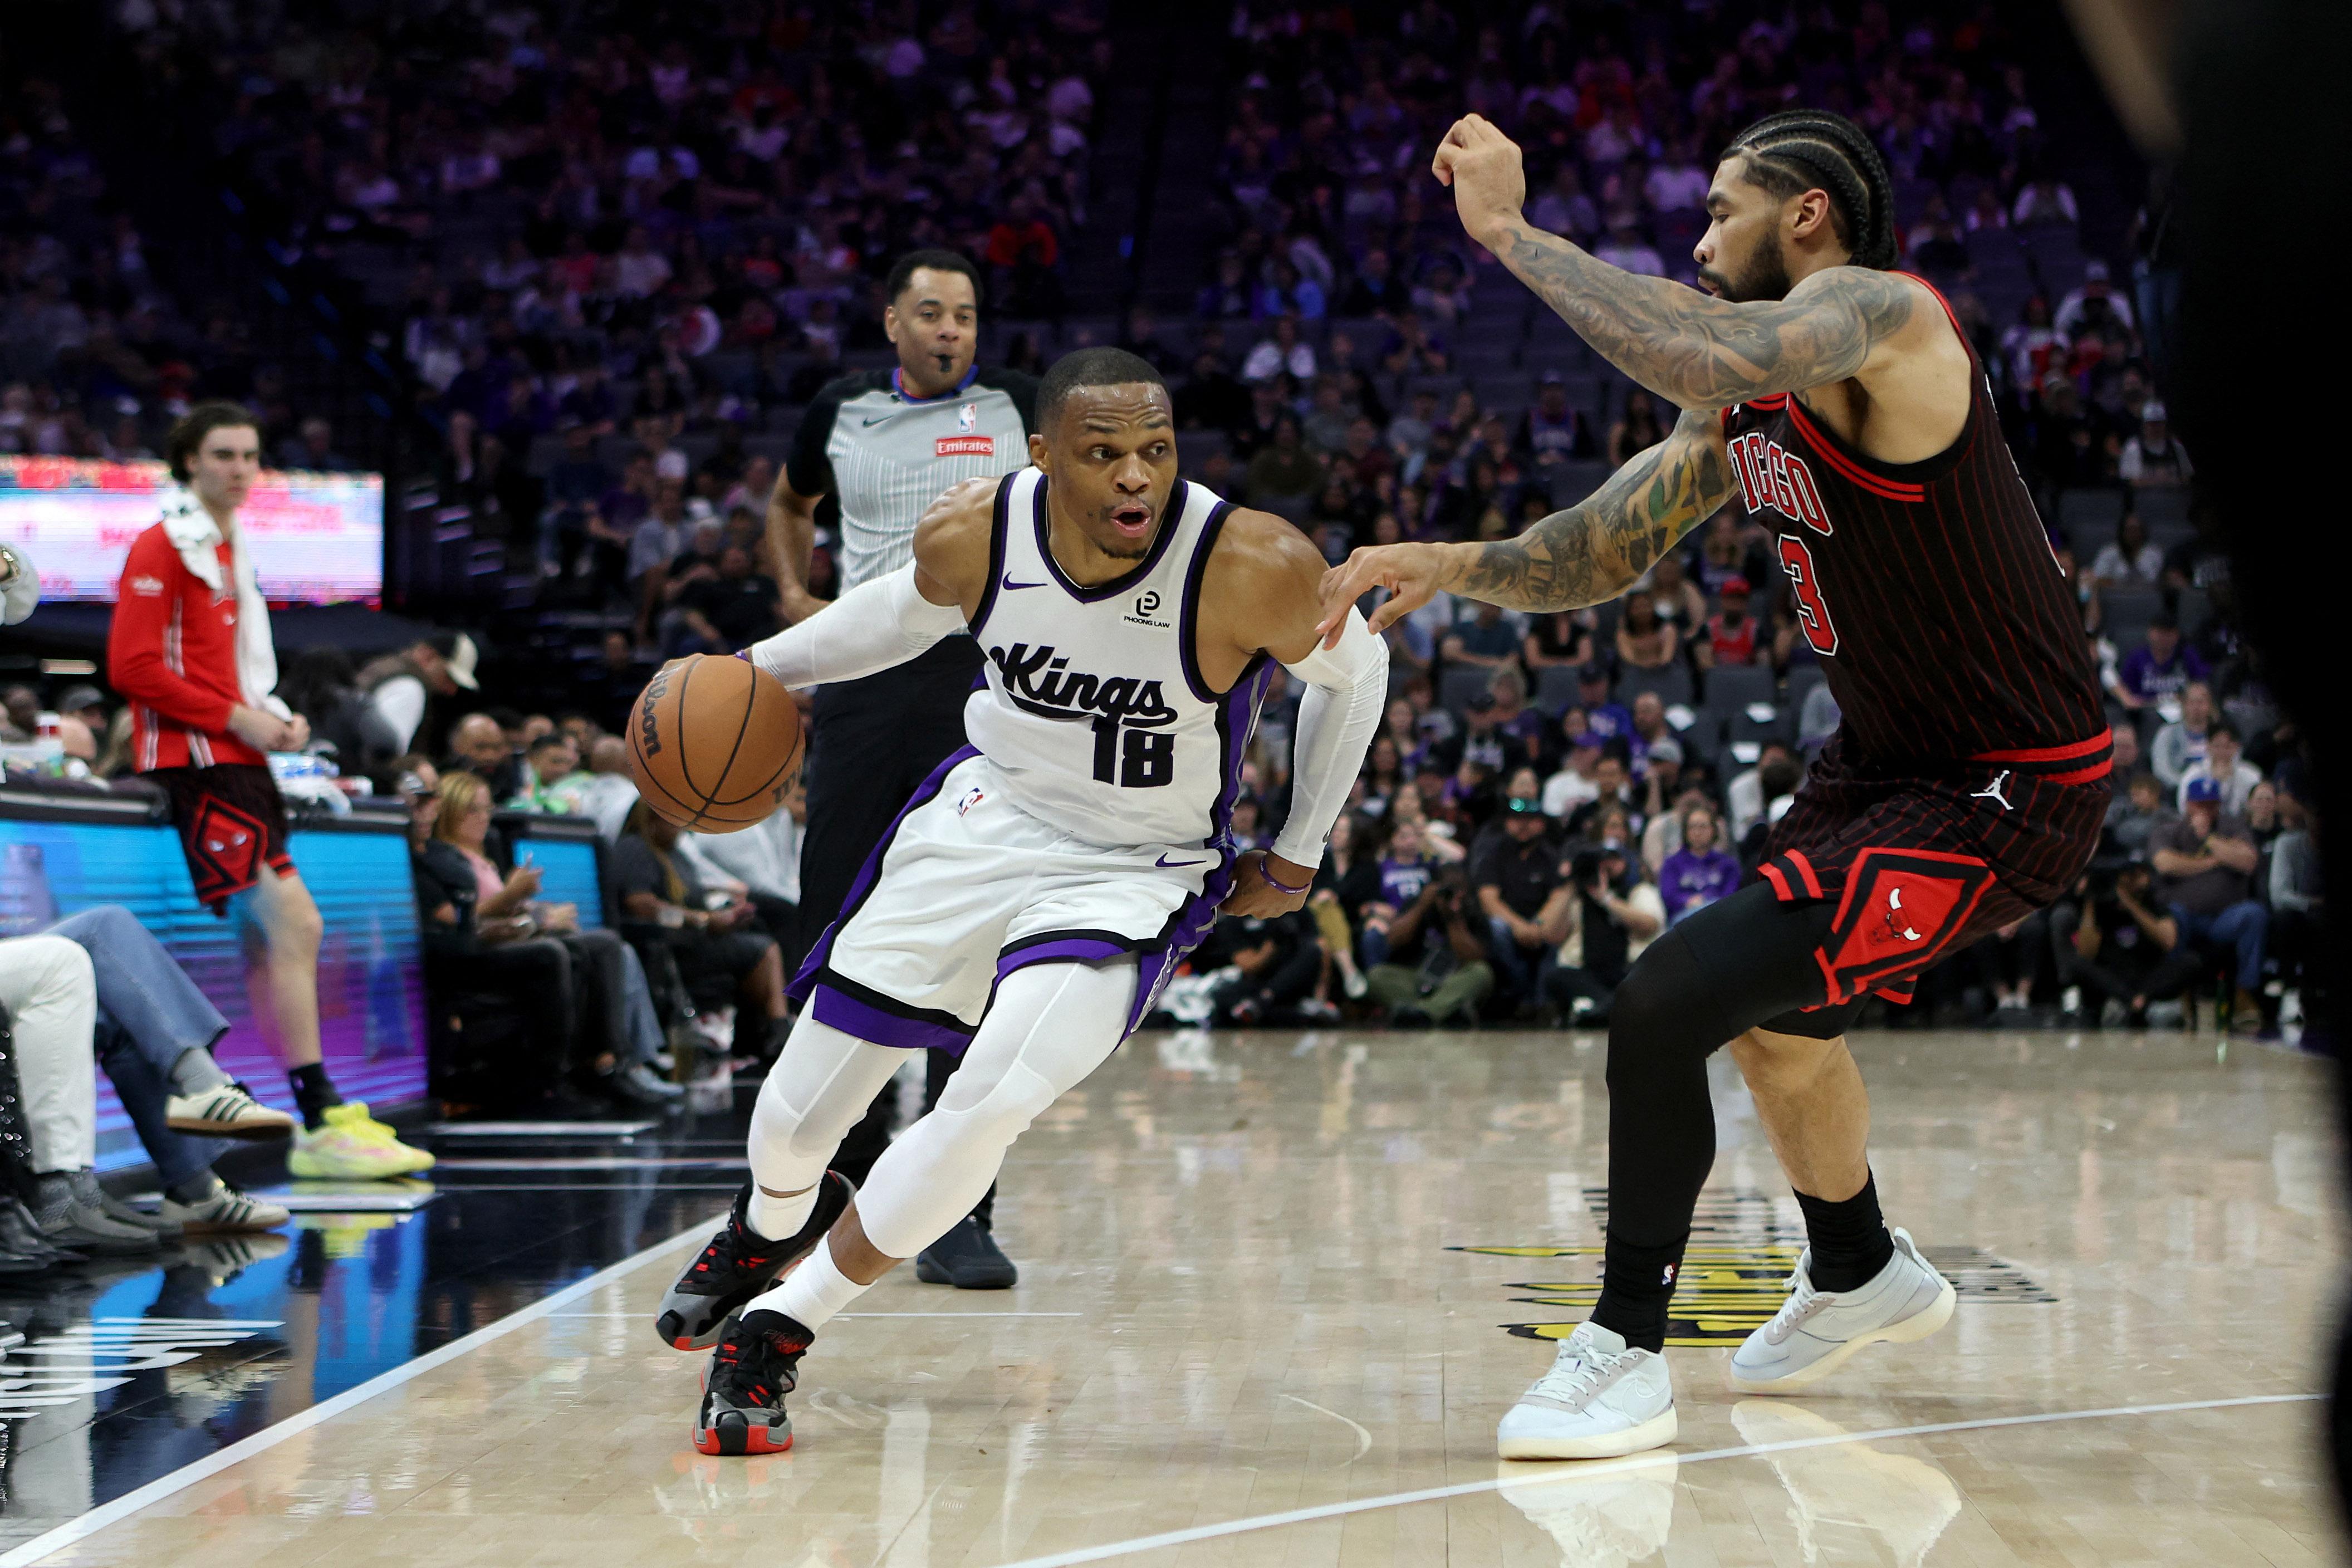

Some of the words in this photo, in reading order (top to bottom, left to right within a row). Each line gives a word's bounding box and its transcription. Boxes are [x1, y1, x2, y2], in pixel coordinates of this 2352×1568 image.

[938, 440, 993, 454] Emirates
[1124, 615, 1153, 626] PHOONG
[1777, 533, 1839, 656] 3
[989, 643, 1178, 728] Kings
[1091, 717, 1177, 788] 18
